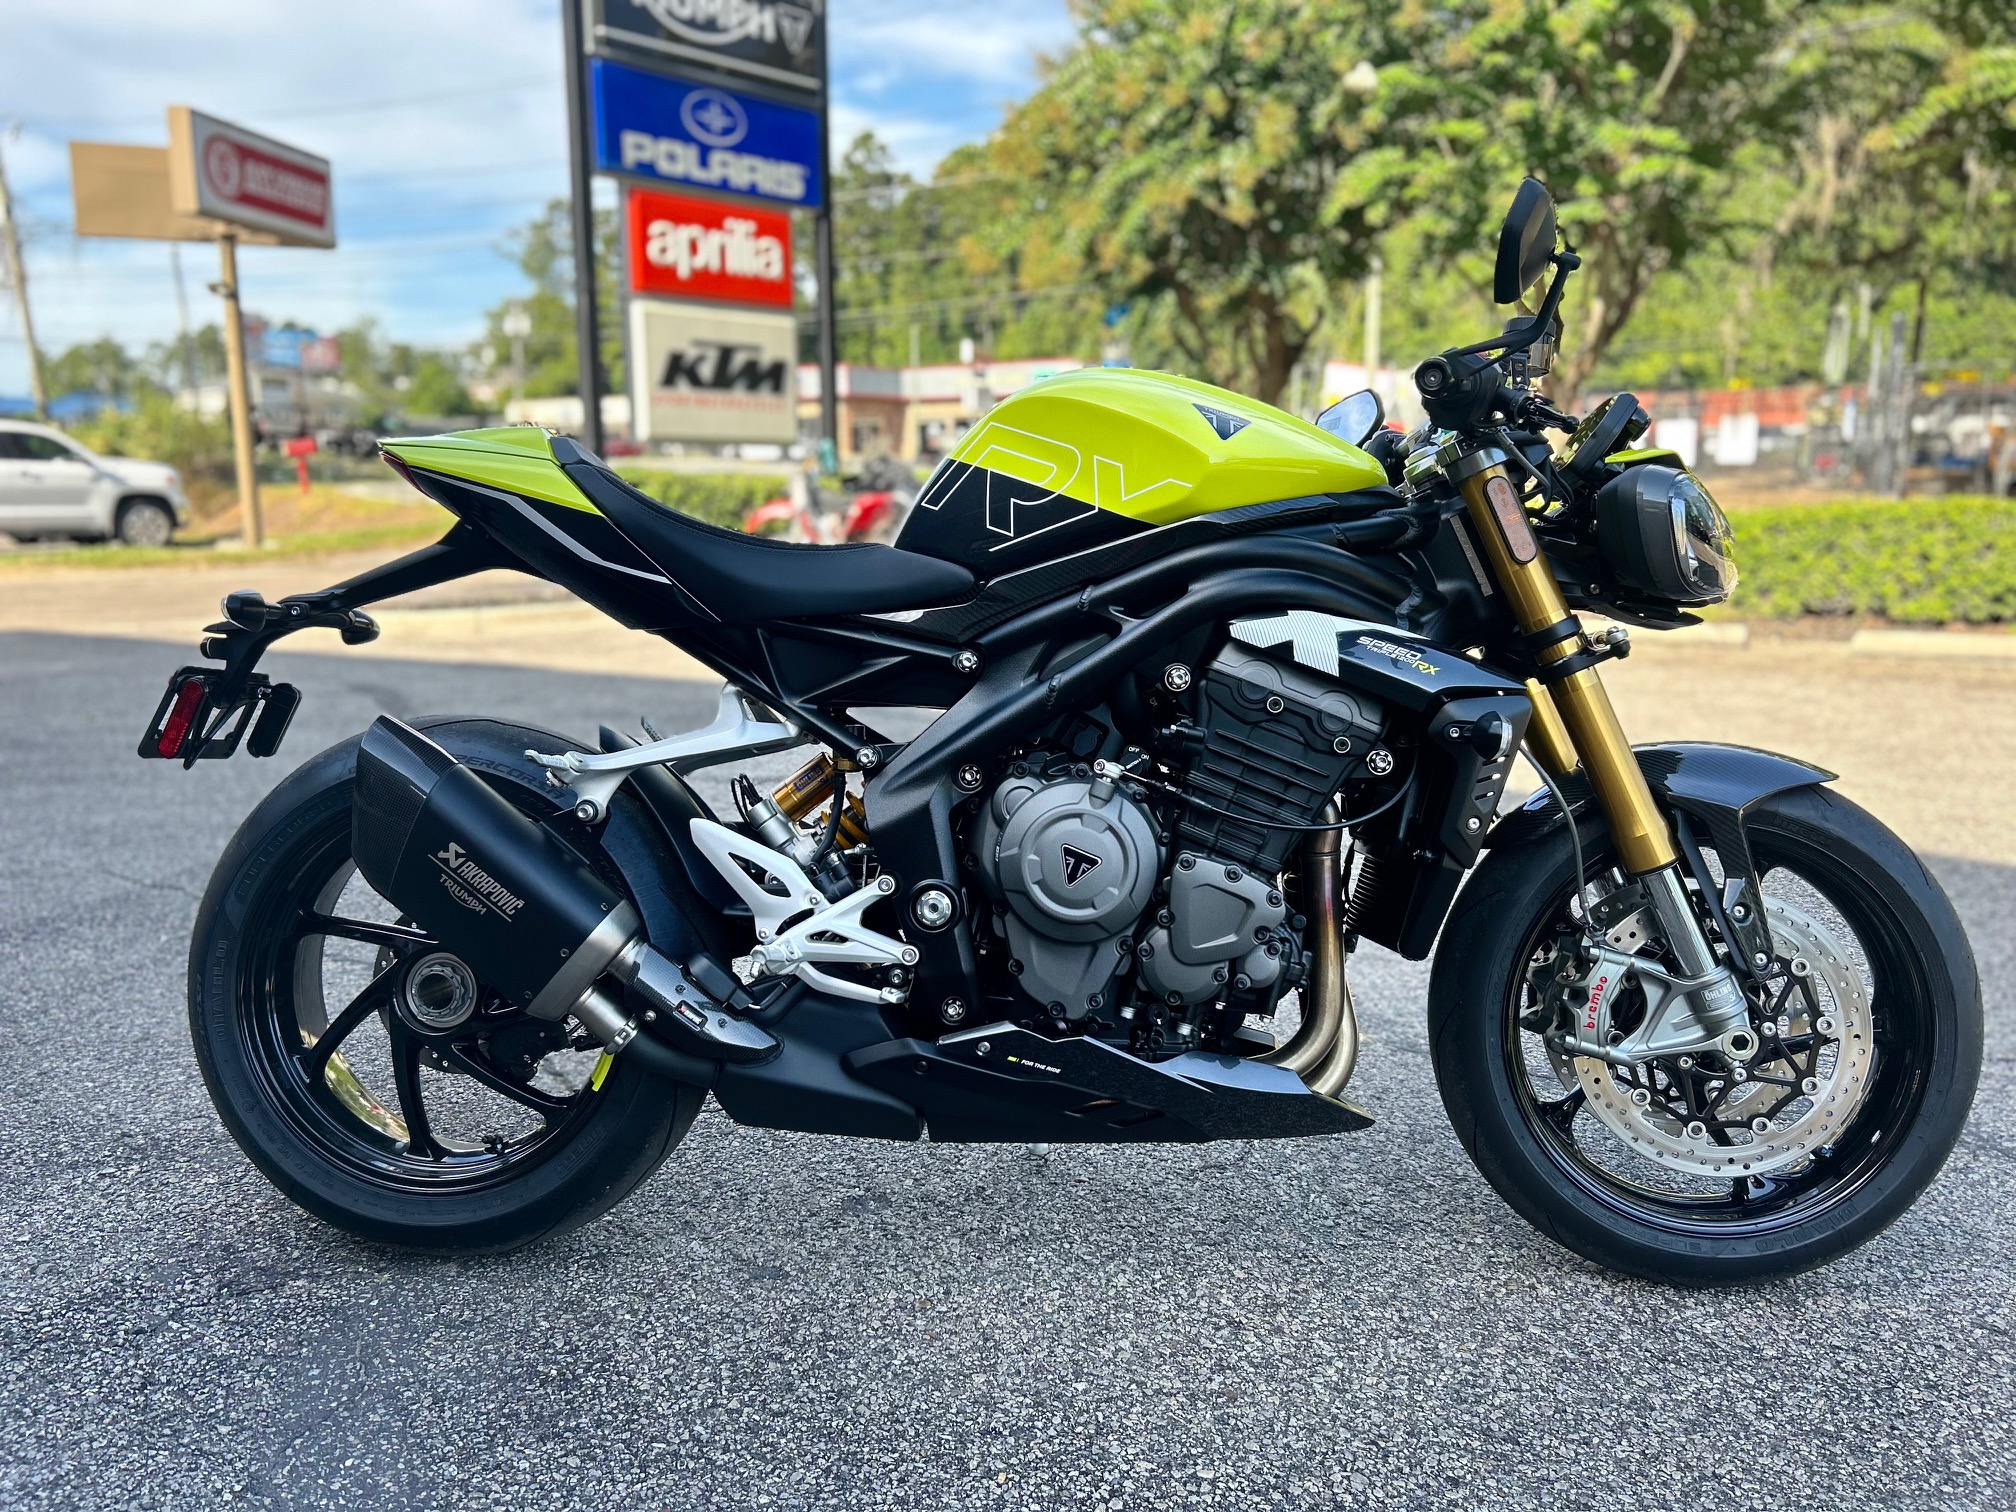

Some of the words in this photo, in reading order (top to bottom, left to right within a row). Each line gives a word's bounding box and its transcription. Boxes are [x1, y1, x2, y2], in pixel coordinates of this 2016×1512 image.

[633, 0, 778, 45] UMPH
[619, 129, 811, 200] POLARIS
[646, 217, 784, 280] aprilia
[659, 340, 788, 394] KTM
[1356, 636, 1422, 660] SPEED
[1411, 660, 1440, 675] RX
[439, 873, 487, 916] TRIUMPH
[1582, 975, 1608, 1030] brembo
[1020, 1059, 1034, 1067] FOR
[1034, 1062, 1047, 1070] THE
[1046, 1065, 1061, 1074] RIDE
